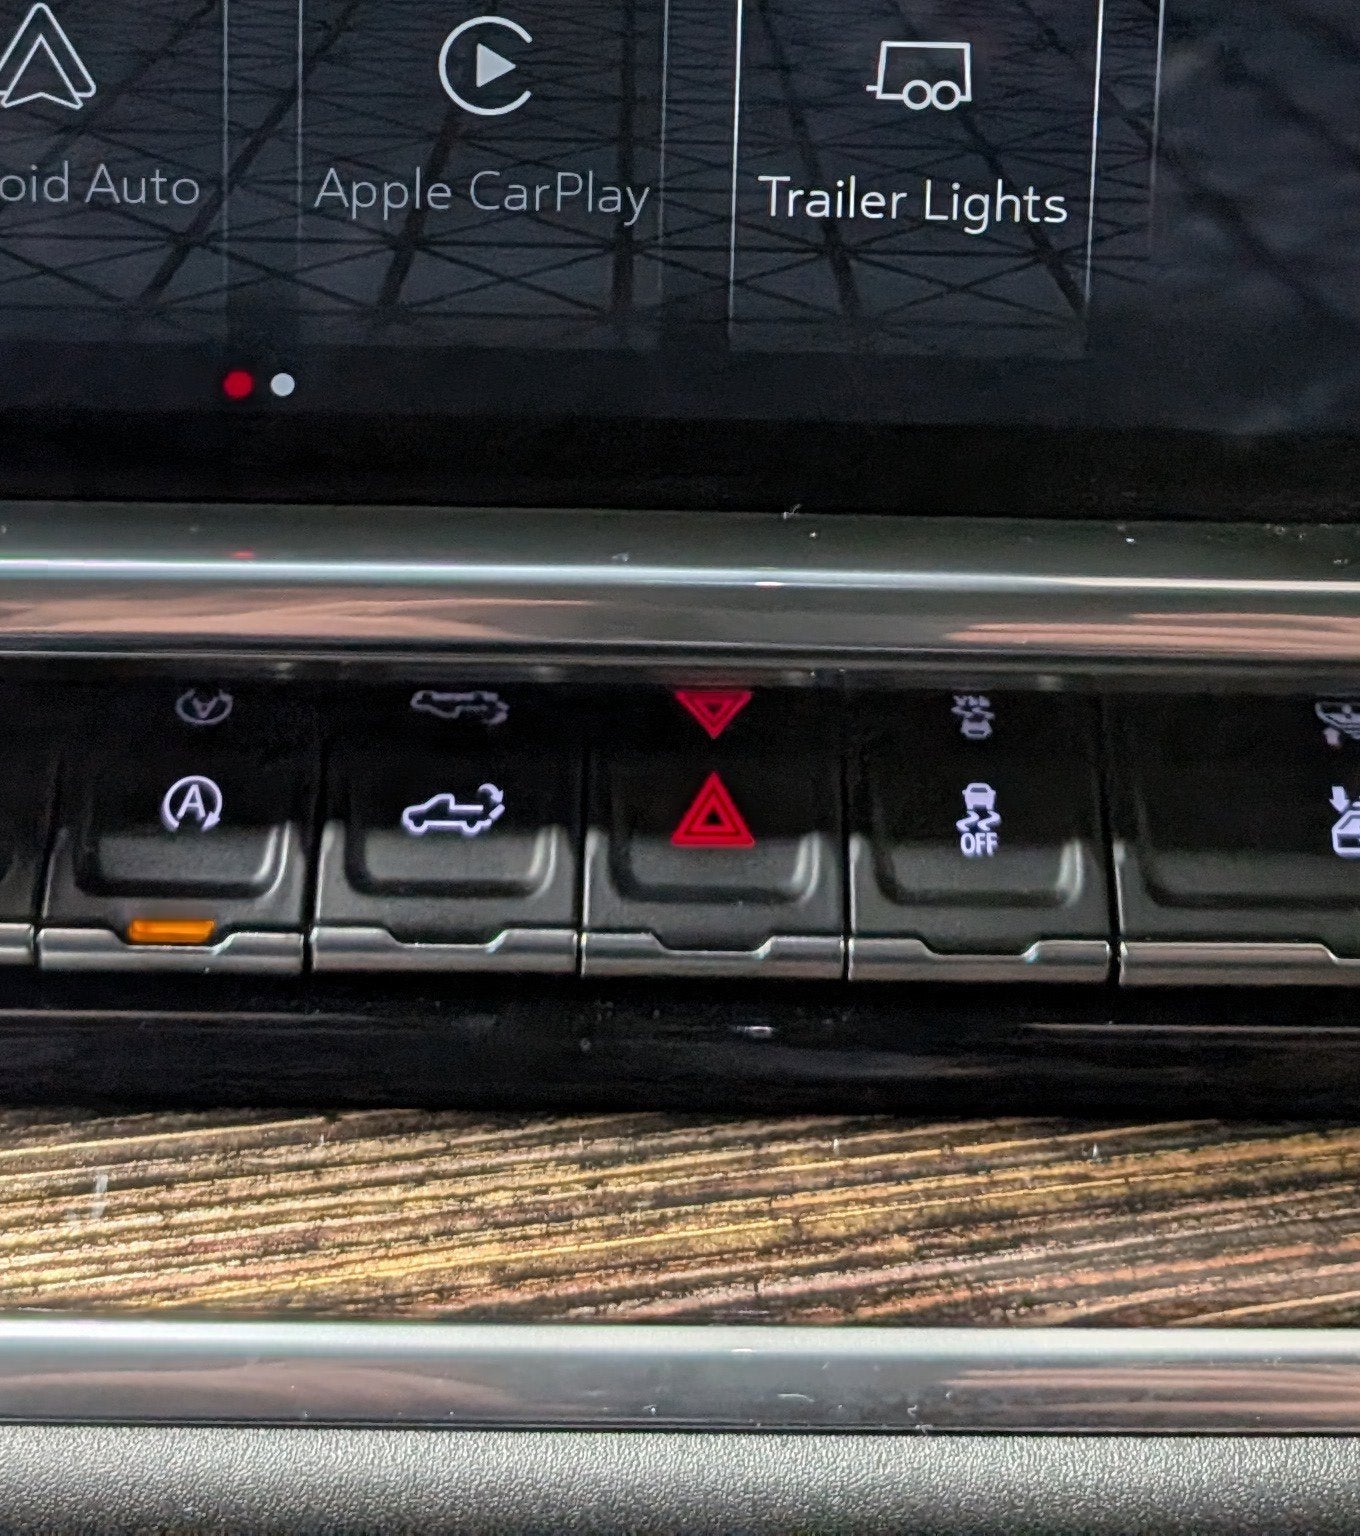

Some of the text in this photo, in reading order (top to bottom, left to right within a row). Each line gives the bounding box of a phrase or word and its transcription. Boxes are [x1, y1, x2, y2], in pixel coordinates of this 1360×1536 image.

[84, 164, 201, 207] Auto
[314, 166, 651, 227] Apple CarPlay
[758, 174, 1069, 236] Trailer Lights
[960, 832, 999, 857] OFF
